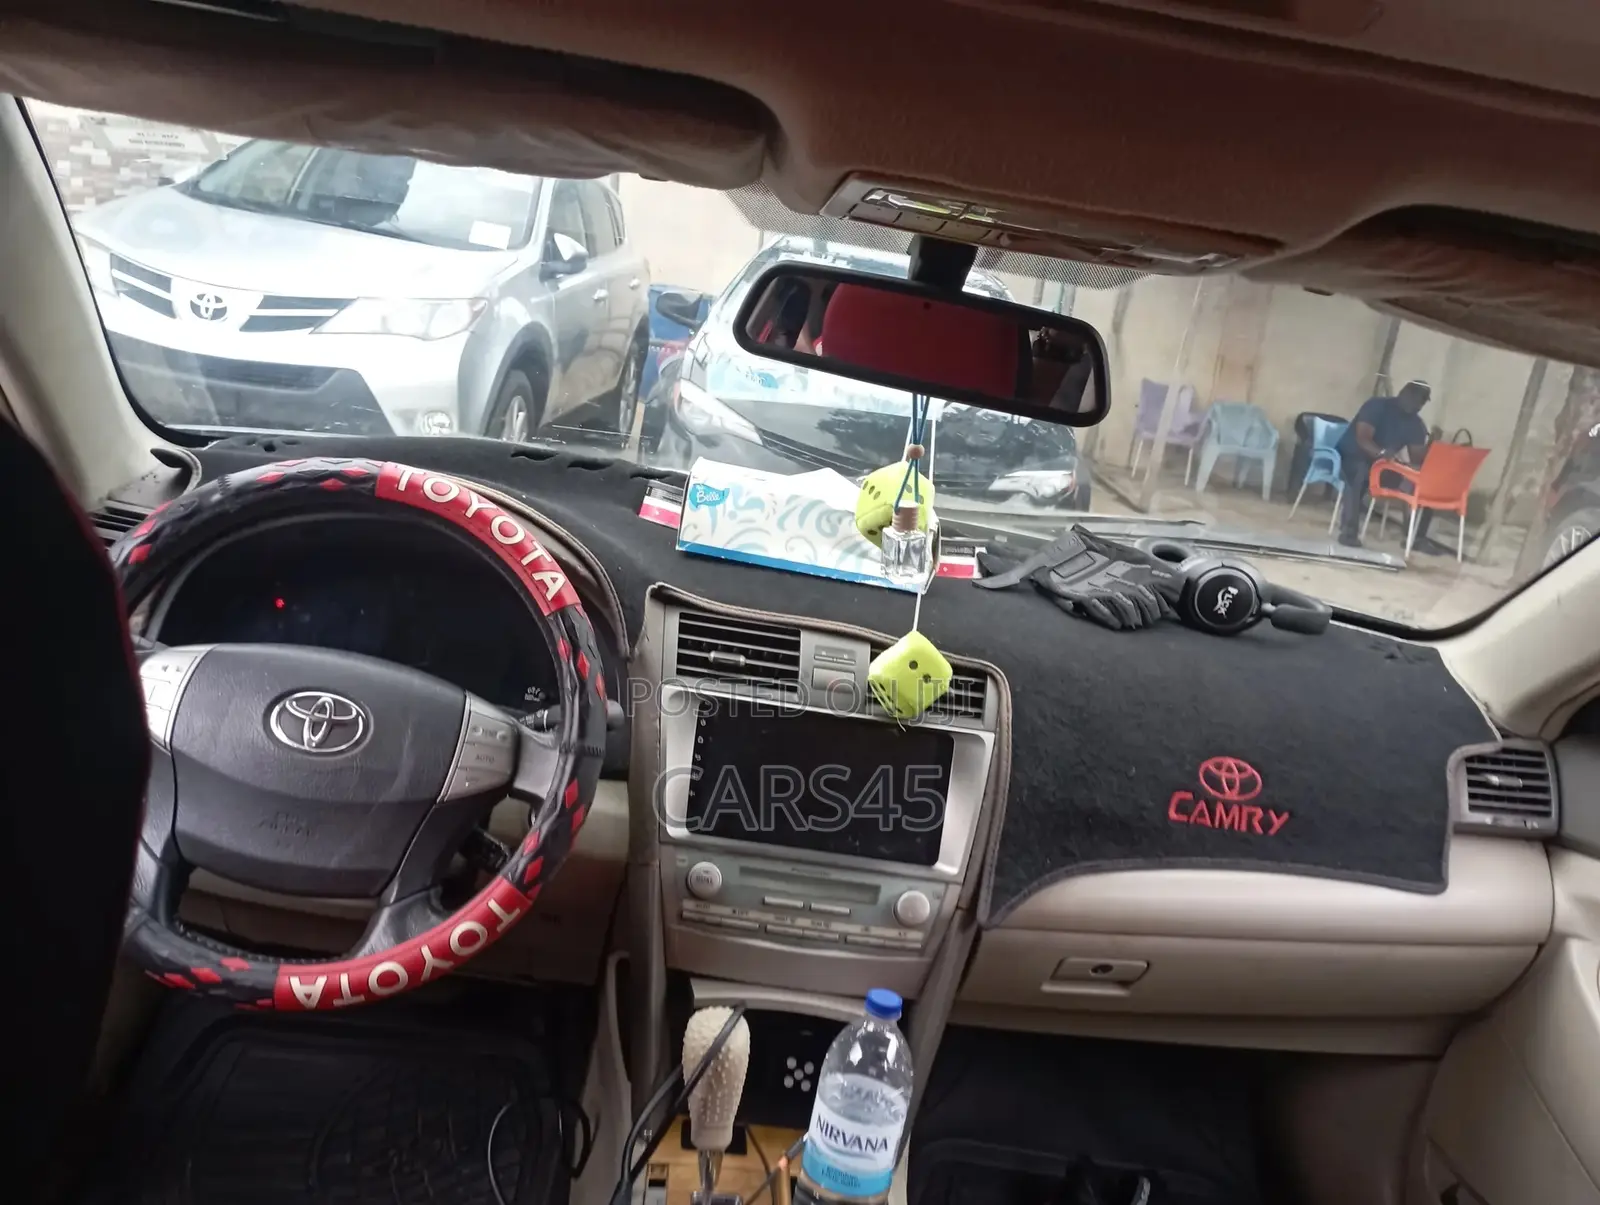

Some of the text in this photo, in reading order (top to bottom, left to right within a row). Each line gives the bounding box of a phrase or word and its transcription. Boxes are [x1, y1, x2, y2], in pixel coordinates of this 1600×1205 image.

[394, 464, 567, 601] TOYOTA
[1167, 790, 1290, 836] CAMRY
[289, 898, 521, 1010] TOYOTA
[816, 1114, 888, 1154] NIRVANA
